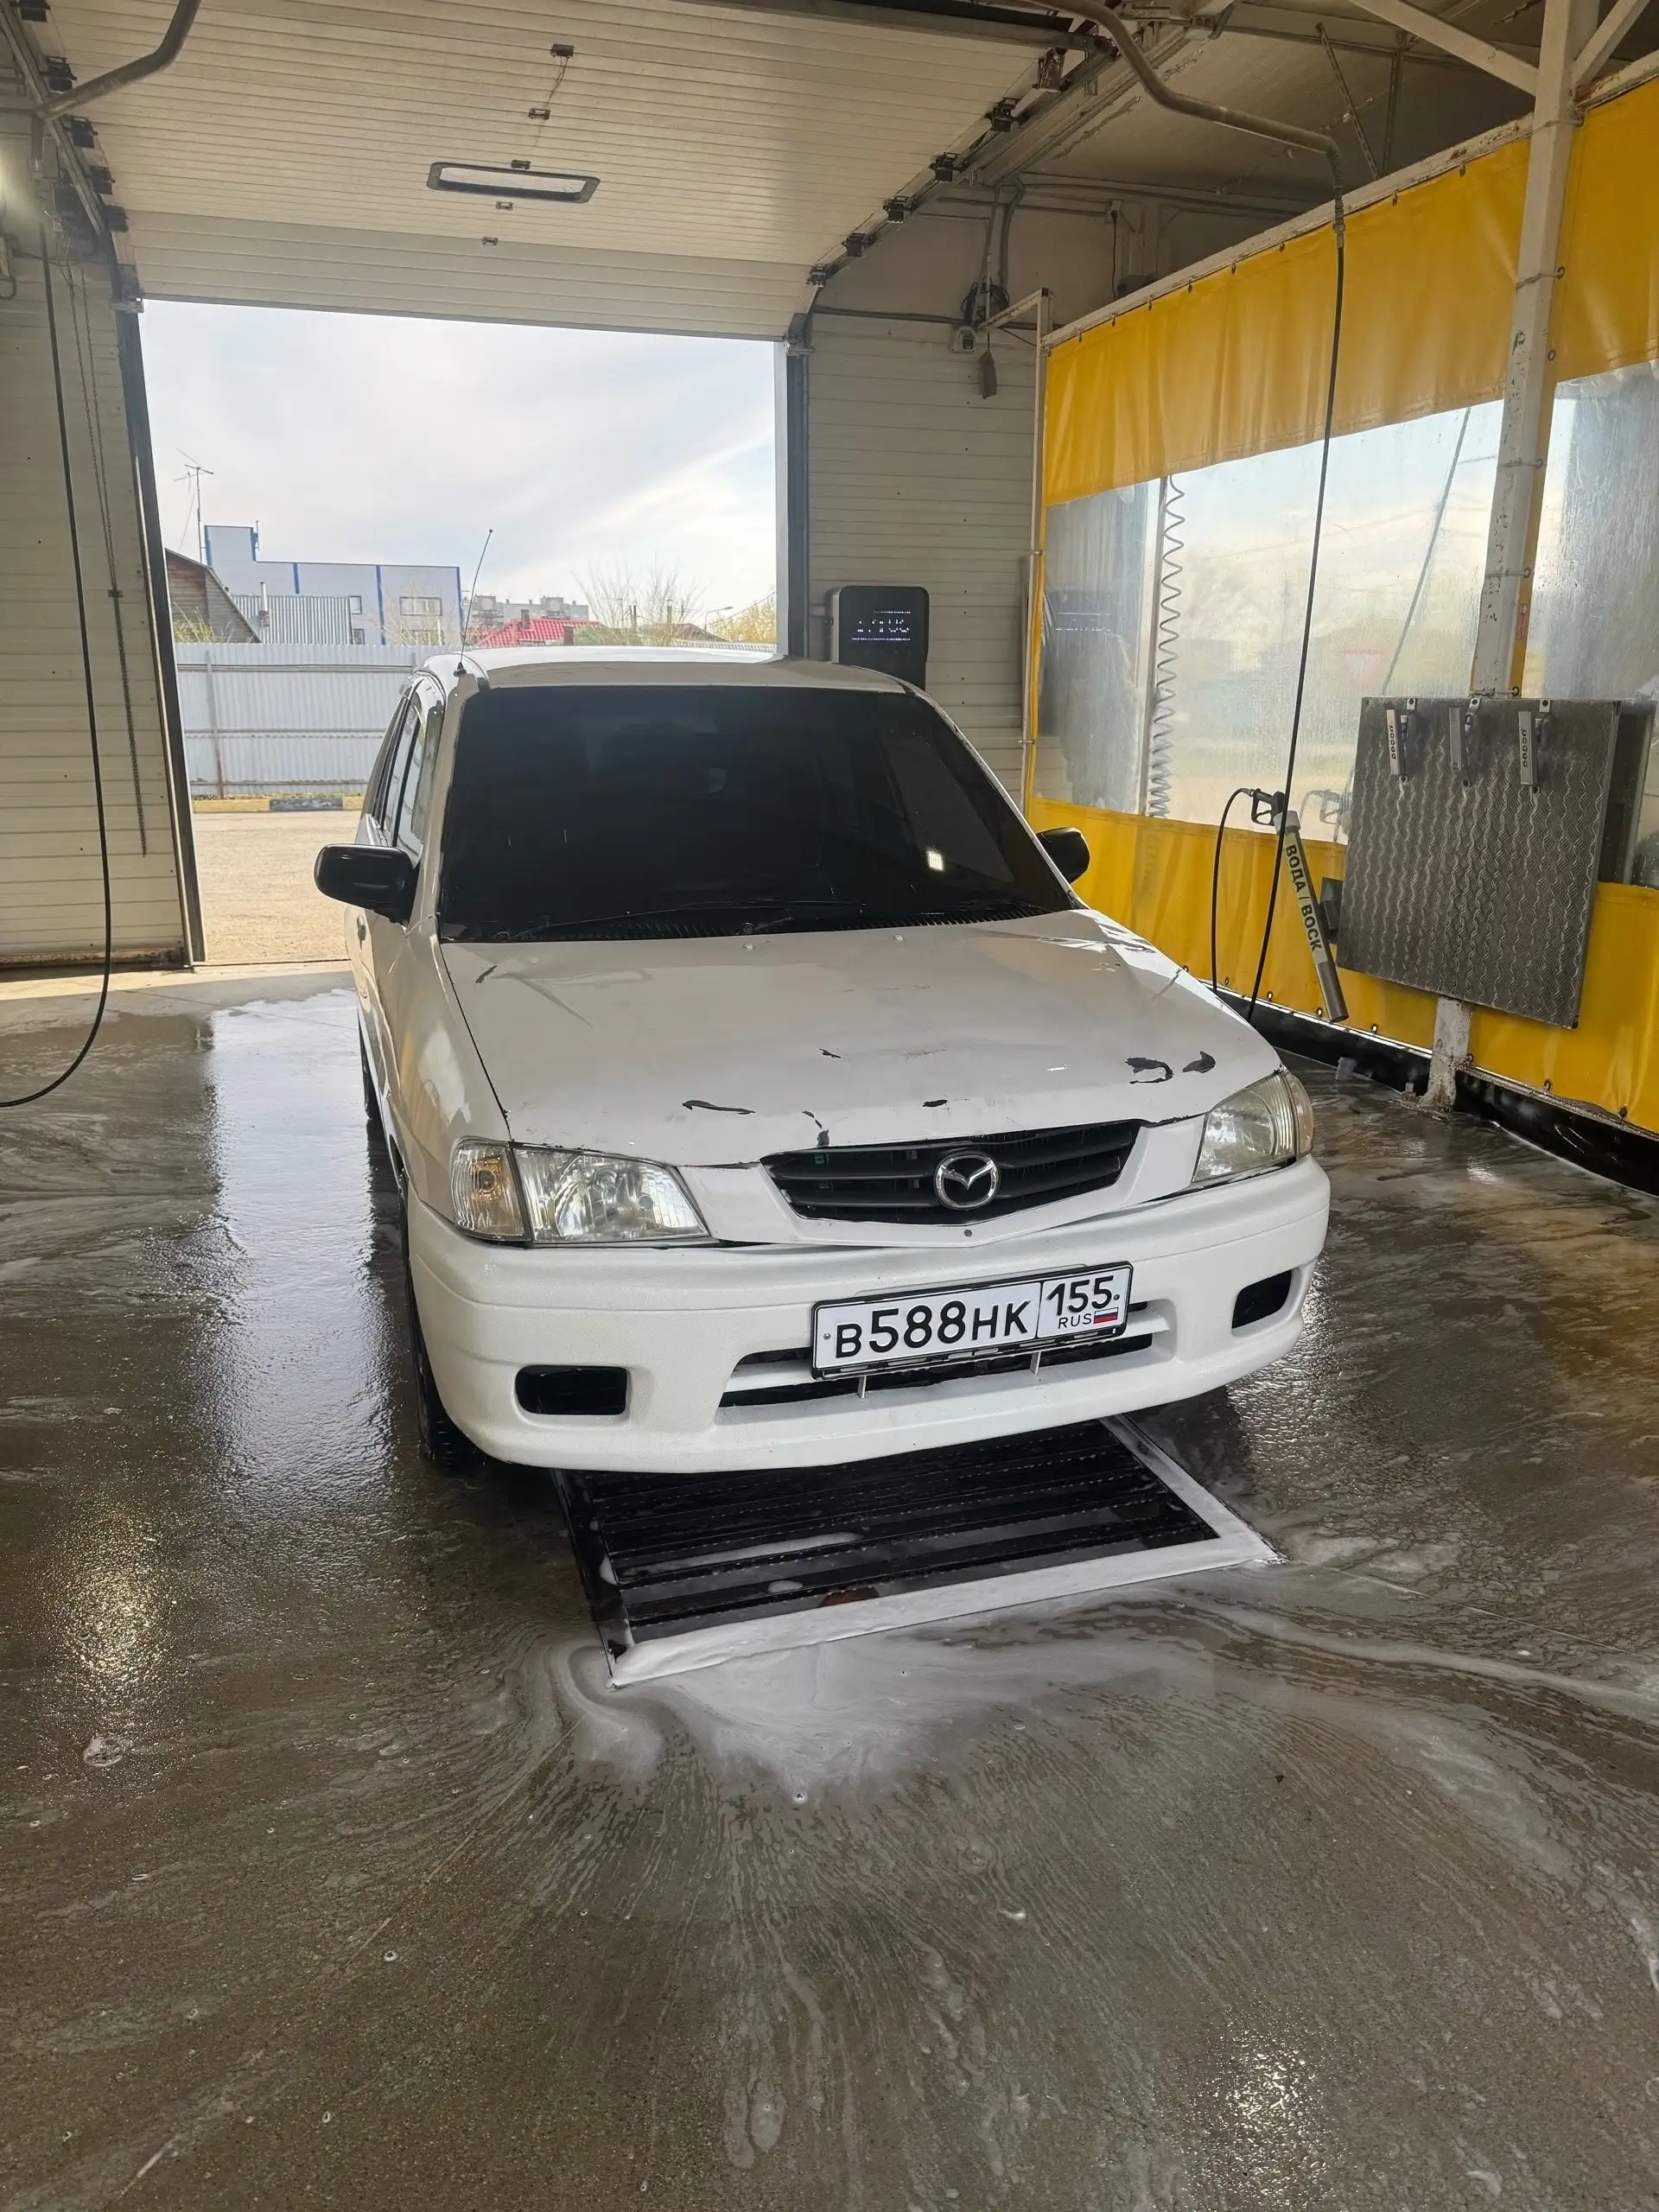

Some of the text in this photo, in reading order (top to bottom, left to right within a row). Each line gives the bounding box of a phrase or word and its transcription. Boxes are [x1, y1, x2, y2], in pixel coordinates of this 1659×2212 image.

[1286, 844, 1306, 893] ВОДА
[1301, 904, 1323, 951] ВОСК
[836, 1275, 1114, 1358] В588НК 155
[1058, 1313, 1092, 1330] RUS
